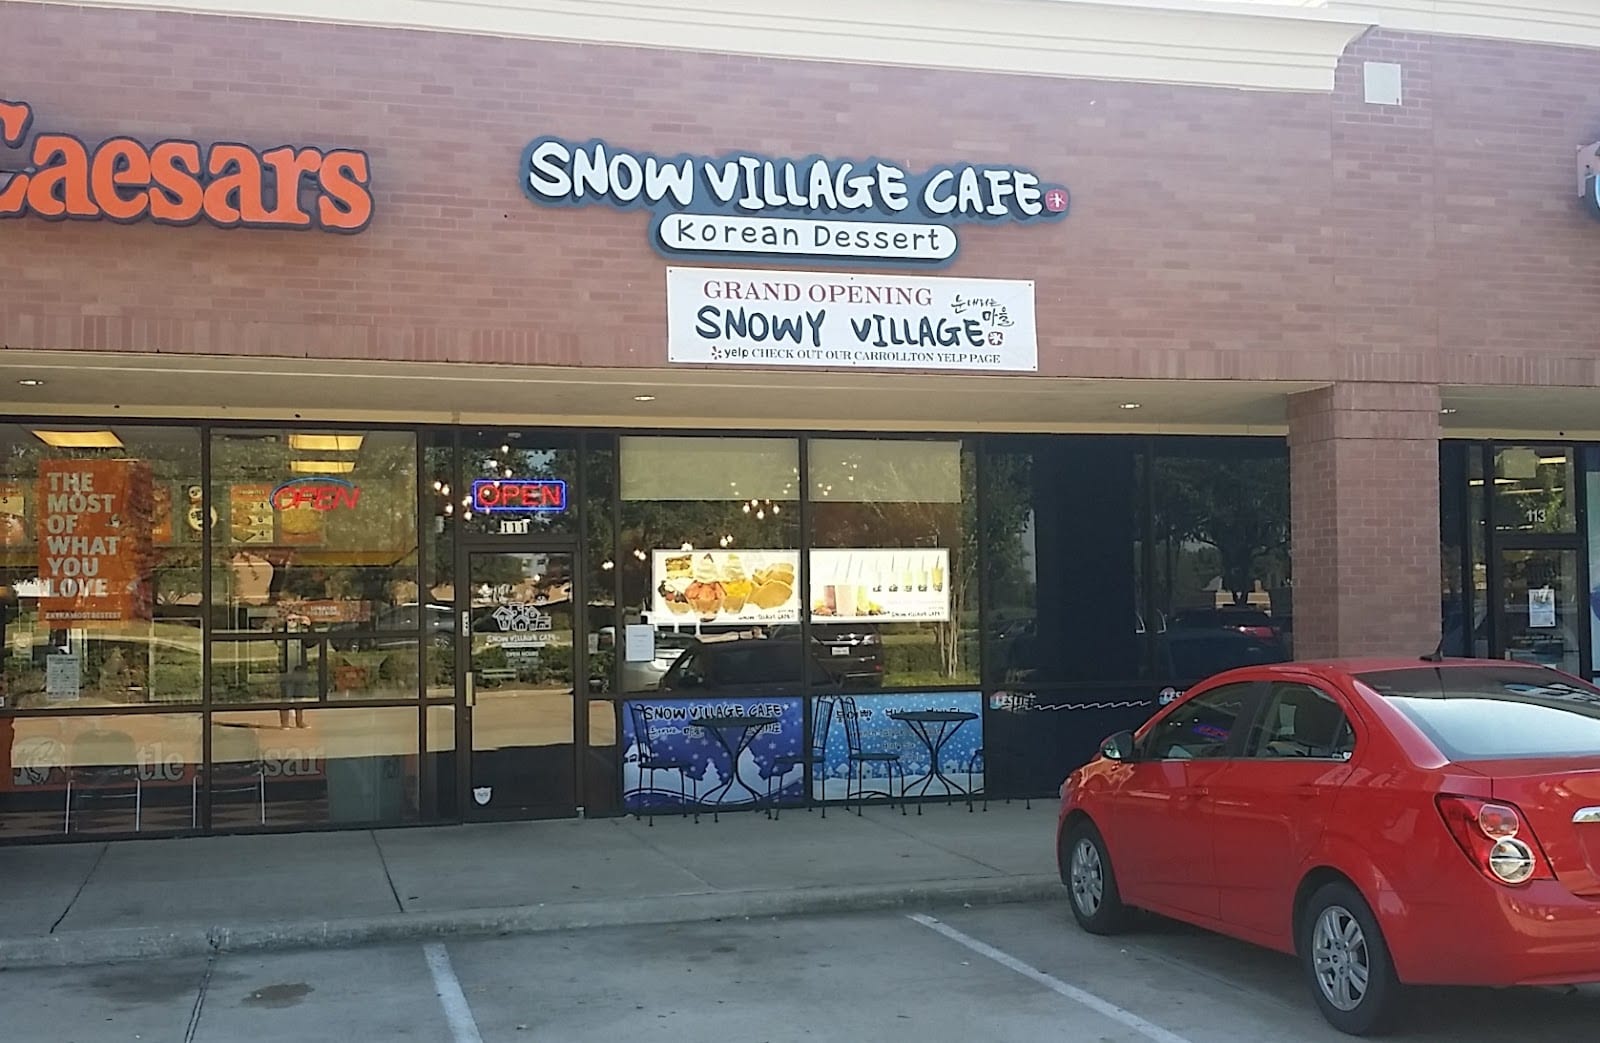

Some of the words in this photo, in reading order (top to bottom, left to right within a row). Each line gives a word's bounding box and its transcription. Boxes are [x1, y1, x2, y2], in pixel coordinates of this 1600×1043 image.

[529, 141, 694, 208] SNOW
[704, 155, 908, 212] VILLAGE
[924, 166, 1043, 215] CAFE
[676, 218, 800, 247] Korean
[814, 224, 940, 252] Dessert
[703, 280, 801, 302] GRAND
[808, 284, 932, 306] OPENING
[695, 305, 826, 348] SNOWY
[850, 313, 985, 348] VILLAGE
[724, 346, 749, 359] yelp
[751, 348, 794, 359] CHECK
[797, 349, 823, 360] OUT
[825, 350, 852, 361] OUR
[854, 351, 934, 362] CARROLLTON
[937, 352, 967, 363] YELP
[969, 353, 1001, 364] PAGE
[47, 472, 94, 492] THE
[47, 494, 116, 513] MOST
[273, 485, 360, 511] OPEN
[478, 484, 562, 506] OPEN
[47, 515, 79, 534] OF
[1526, 508, 1546, 523] 113
[503, 521, 528, 533] 111
[47, 536, 120, 555] WHAT
[47, 557, 99, 577] YOU
[49, 578, 109, 598] LOVE
[643, 705, 687, 721] SNOW
[689, 704, 745, 720] VILLAGE
[748, 702, 783, 717] CAFE
